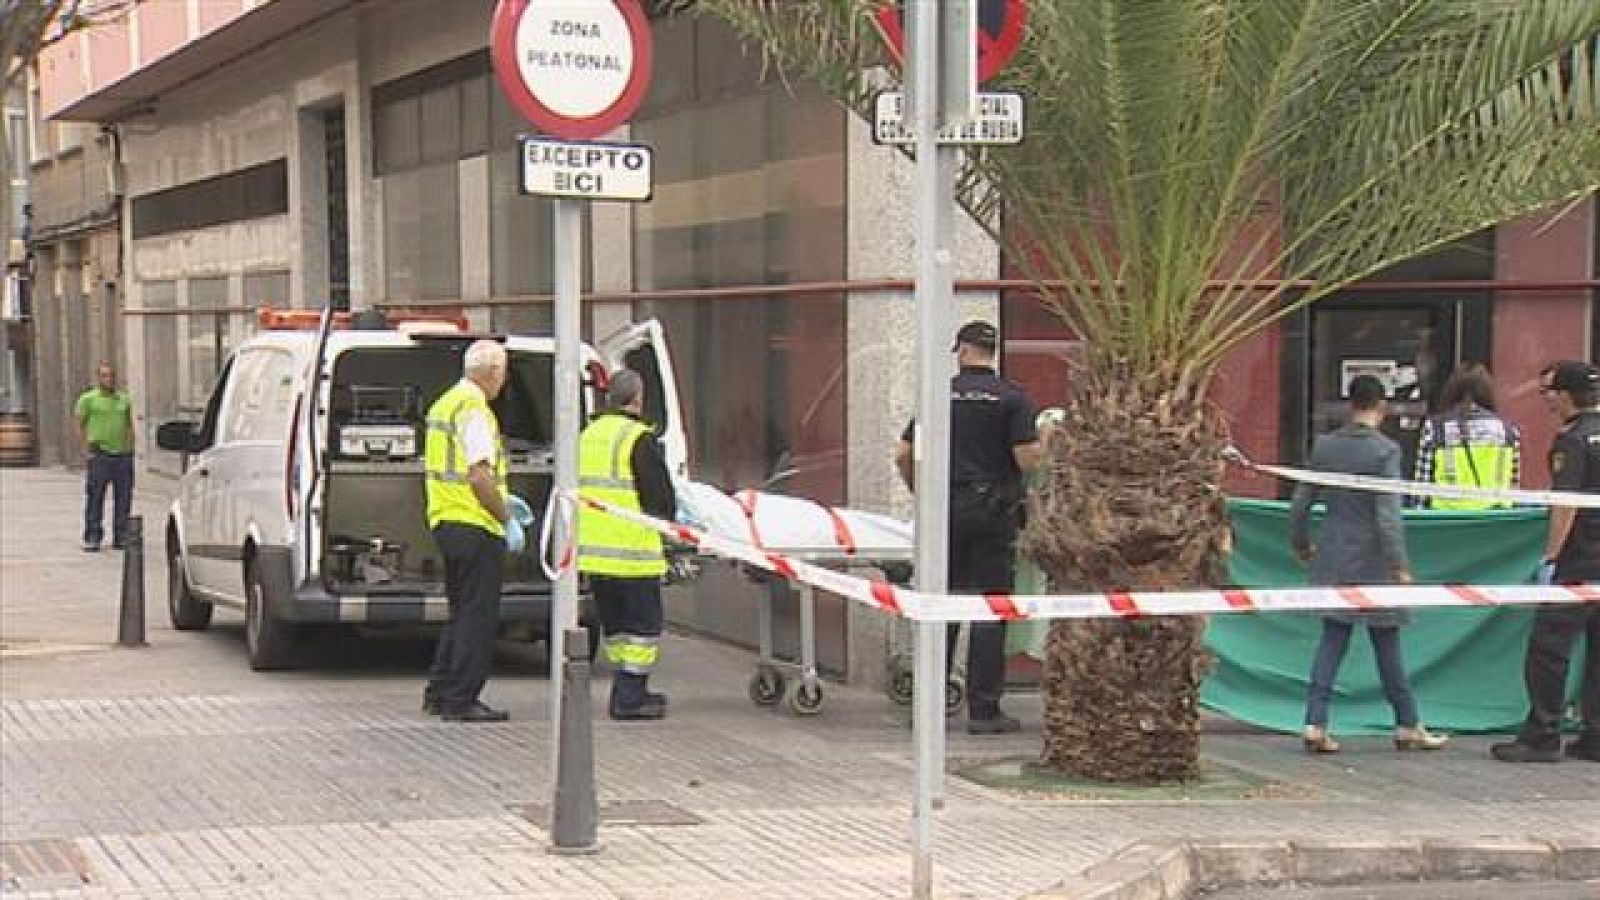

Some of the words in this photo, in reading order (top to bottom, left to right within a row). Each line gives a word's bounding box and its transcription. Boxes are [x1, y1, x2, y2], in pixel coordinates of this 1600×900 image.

[550, 19, 601, 37] ZONA
[527, 49, 622, 72] PEATONAL
[528, 145, 644, 171] EXCEPTO
[554, 171, 604, 193] BICI
